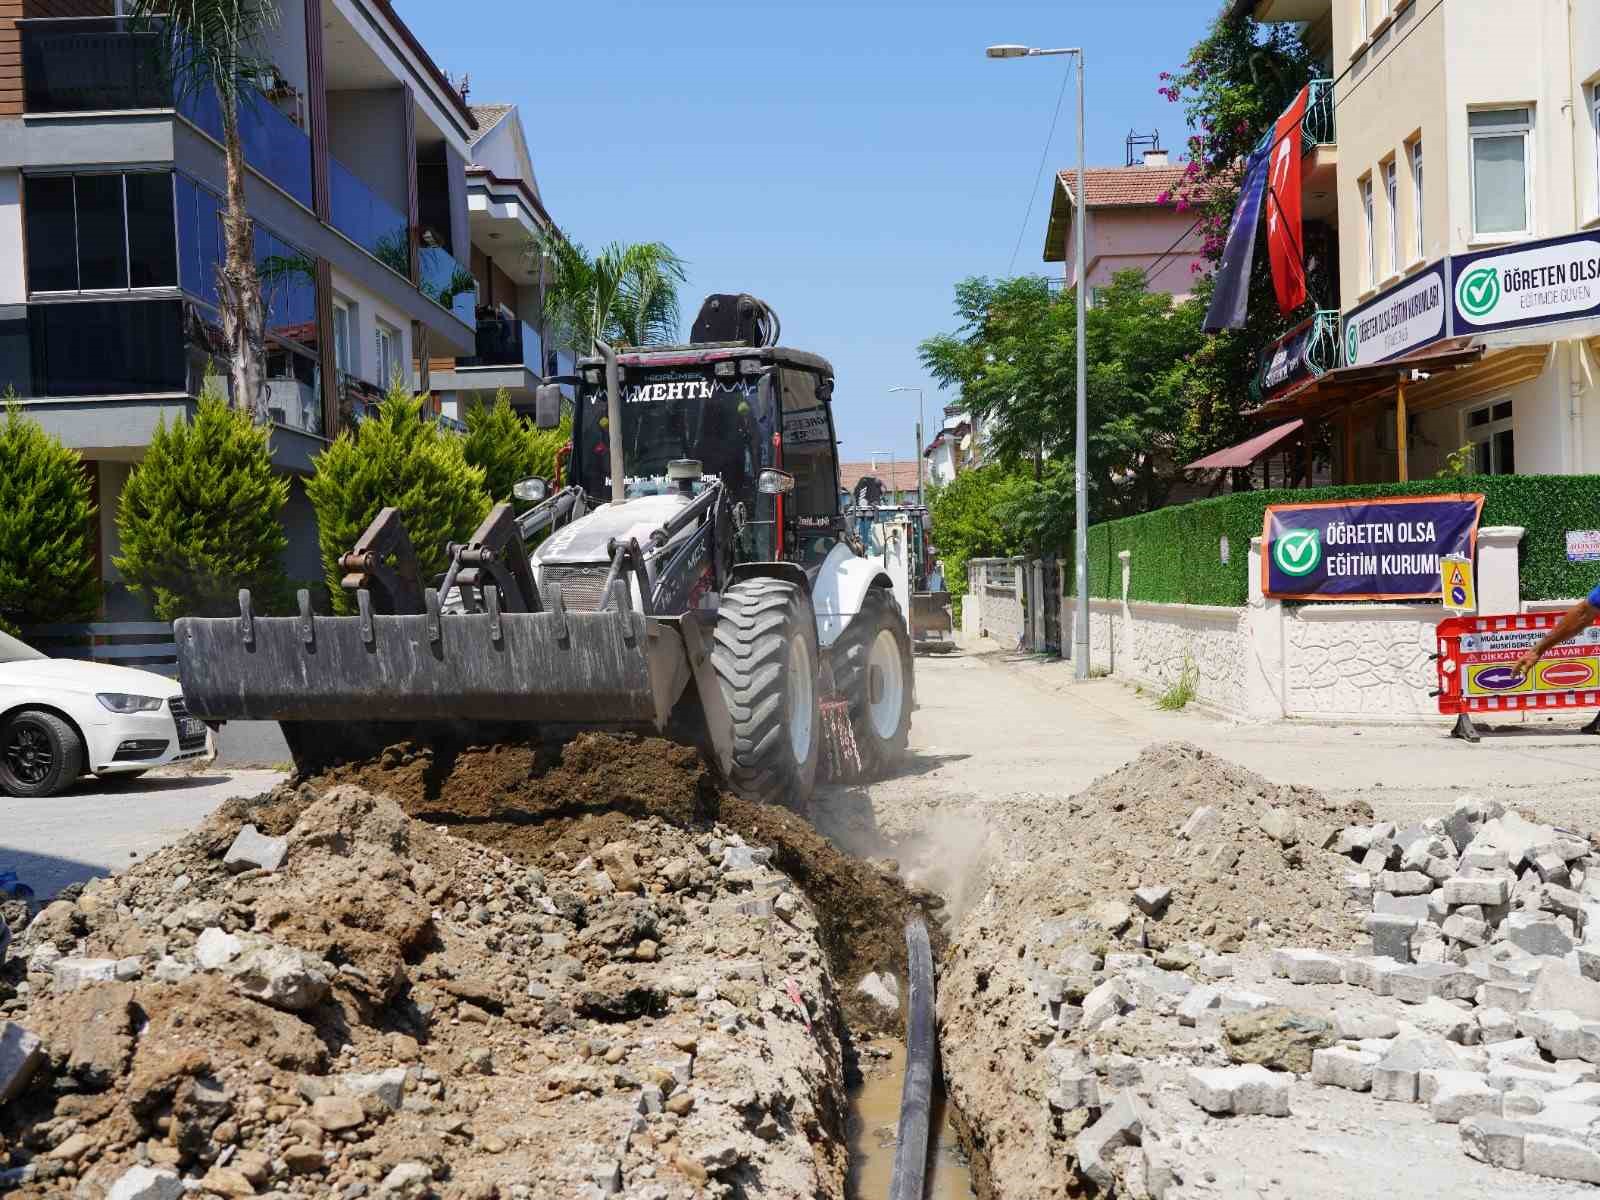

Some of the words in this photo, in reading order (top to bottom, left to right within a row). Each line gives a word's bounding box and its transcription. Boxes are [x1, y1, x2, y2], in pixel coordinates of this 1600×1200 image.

[1504, 264, 1566, 293] ÖĞRETEN
[1326, 522, 1393, 545] ÖĞRETEN
[1398, 521, 1436, 543] OLSA
[1327, 552, 1377, 576] EĞİTİM
[1381, 553, 1464, 576] KURUML
[1481, 651, 1515, 661] DİKKAT
